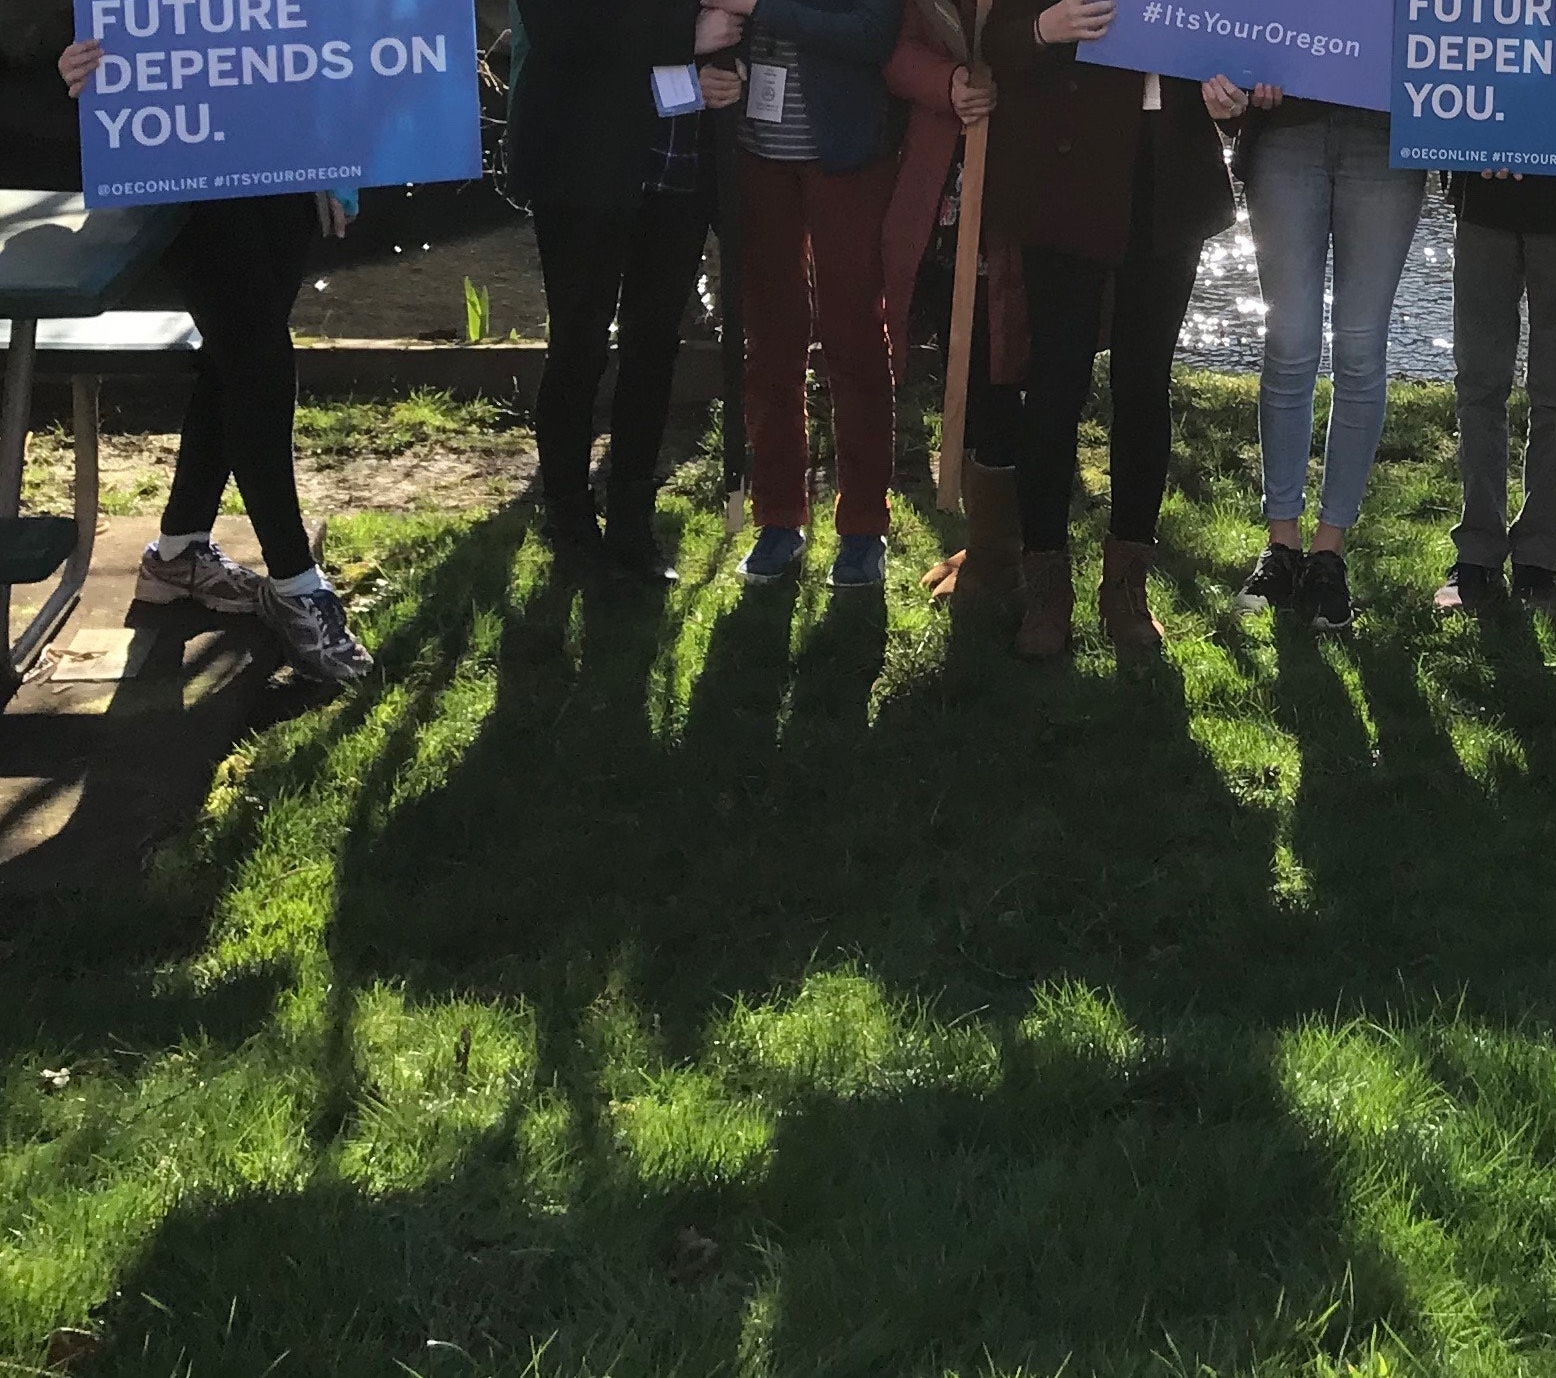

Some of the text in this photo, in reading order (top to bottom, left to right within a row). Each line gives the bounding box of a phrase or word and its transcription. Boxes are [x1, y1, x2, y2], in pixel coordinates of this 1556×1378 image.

[1142, 1, 1361, 58] #ItsYourOregon
[95, 34, 447, 95] DEPENDS ON
[1403, 82, 1505, 122] YOU.
[94, 102, 226, 149] YOU.
[1400, 147, 1488, 162] @OECONLINE
[97, 164, 362, 197] @OECONLINE #ITSYOUROREGON
